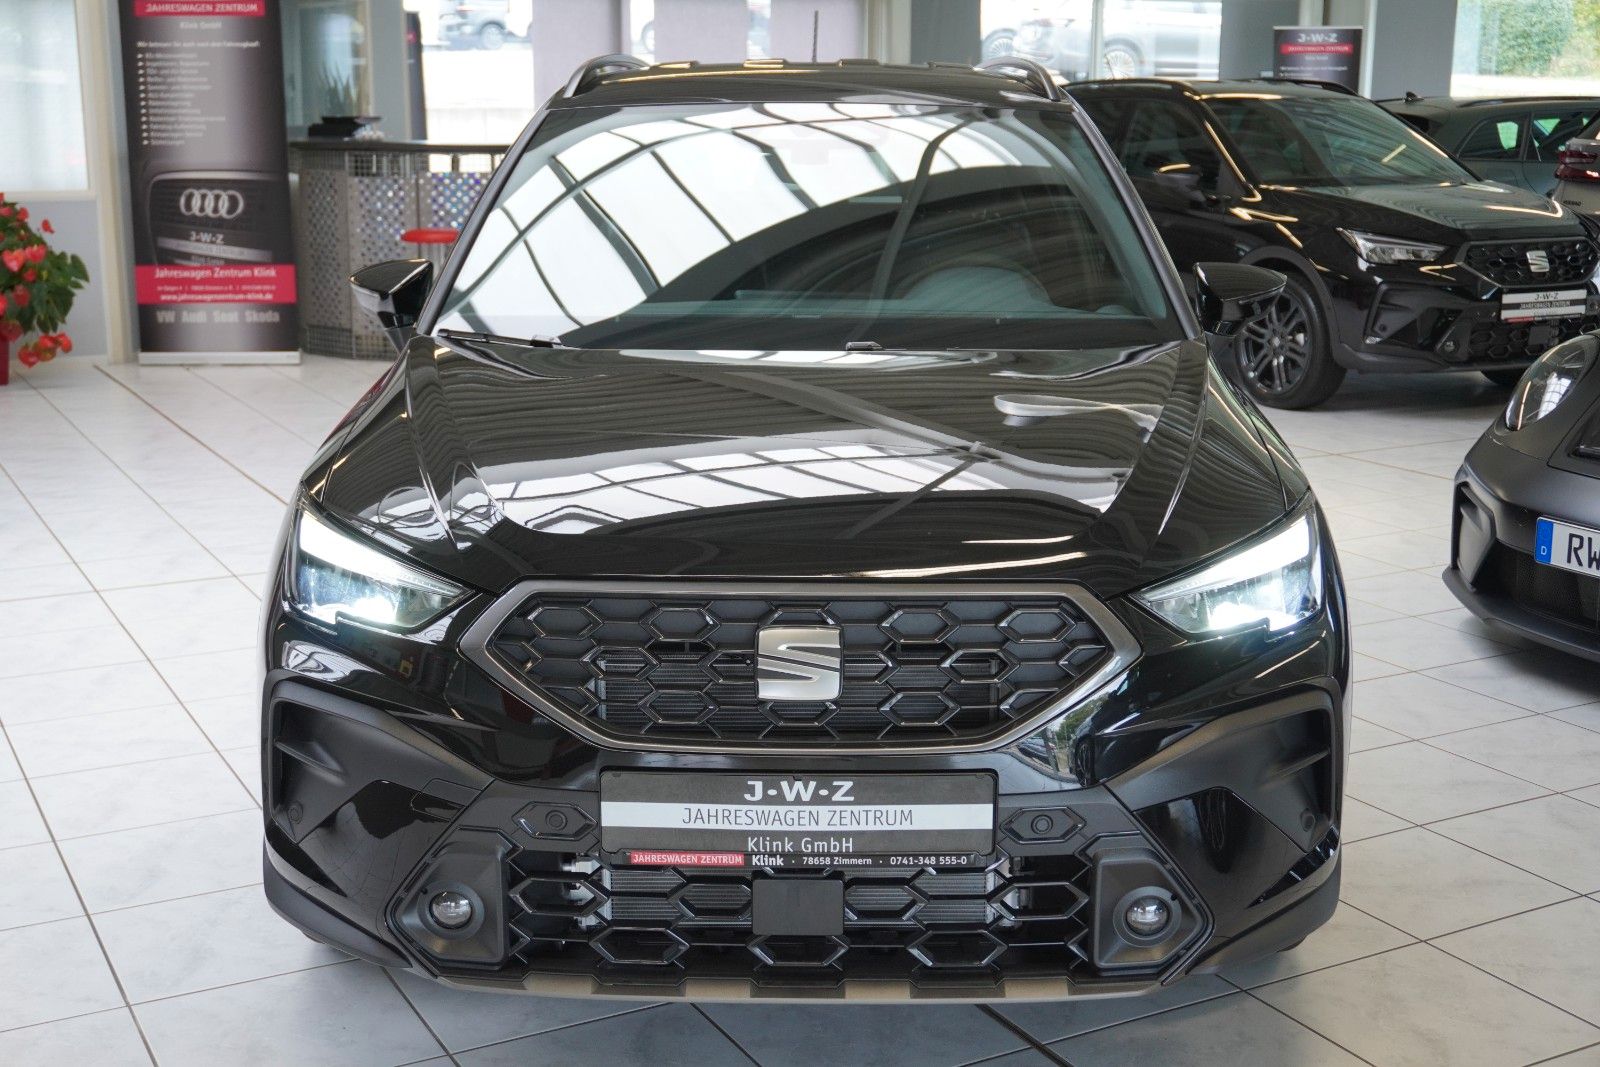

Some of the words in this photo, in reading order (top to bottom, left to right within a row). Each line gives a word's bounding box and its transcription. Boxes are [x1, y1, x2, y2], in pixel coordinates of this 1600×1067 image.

[145, 3, 213, 13] JAHRESWAGEN
[214, 3, 258, 12] ZENTRUM
[155, 267, 212, 280] Jahreswagen
[213, 267, 252, 278] Zentrum
[253, 267, 277, 278] Klink
[156, 310, 176, 323] VW
[182, 310, 207, 323] Audi
[214, 310, 239, 323] Seat
[245, 310, 281, 323] Skoda
[1541, 546, 1547, 555] D
[682, 807, 820, 826] JAHRESWAGEN
[827, 809, 913, 827] ZENTRUM
[747, 836, 794, 853] Klink
[801, 837, 854, 853] GmbH
[633, 854, 698, 864] JAHRESWAGEN
[700, 855, 742, 864] ZENTRUM
[751, 854, 785, 866] Klink
[802, 856, 831, 865] 78658
[833, 856, 872, 865] Zimmern
[890, 856, 936, 865] 0741-348
[939, 856, 967, 865] 555-0
